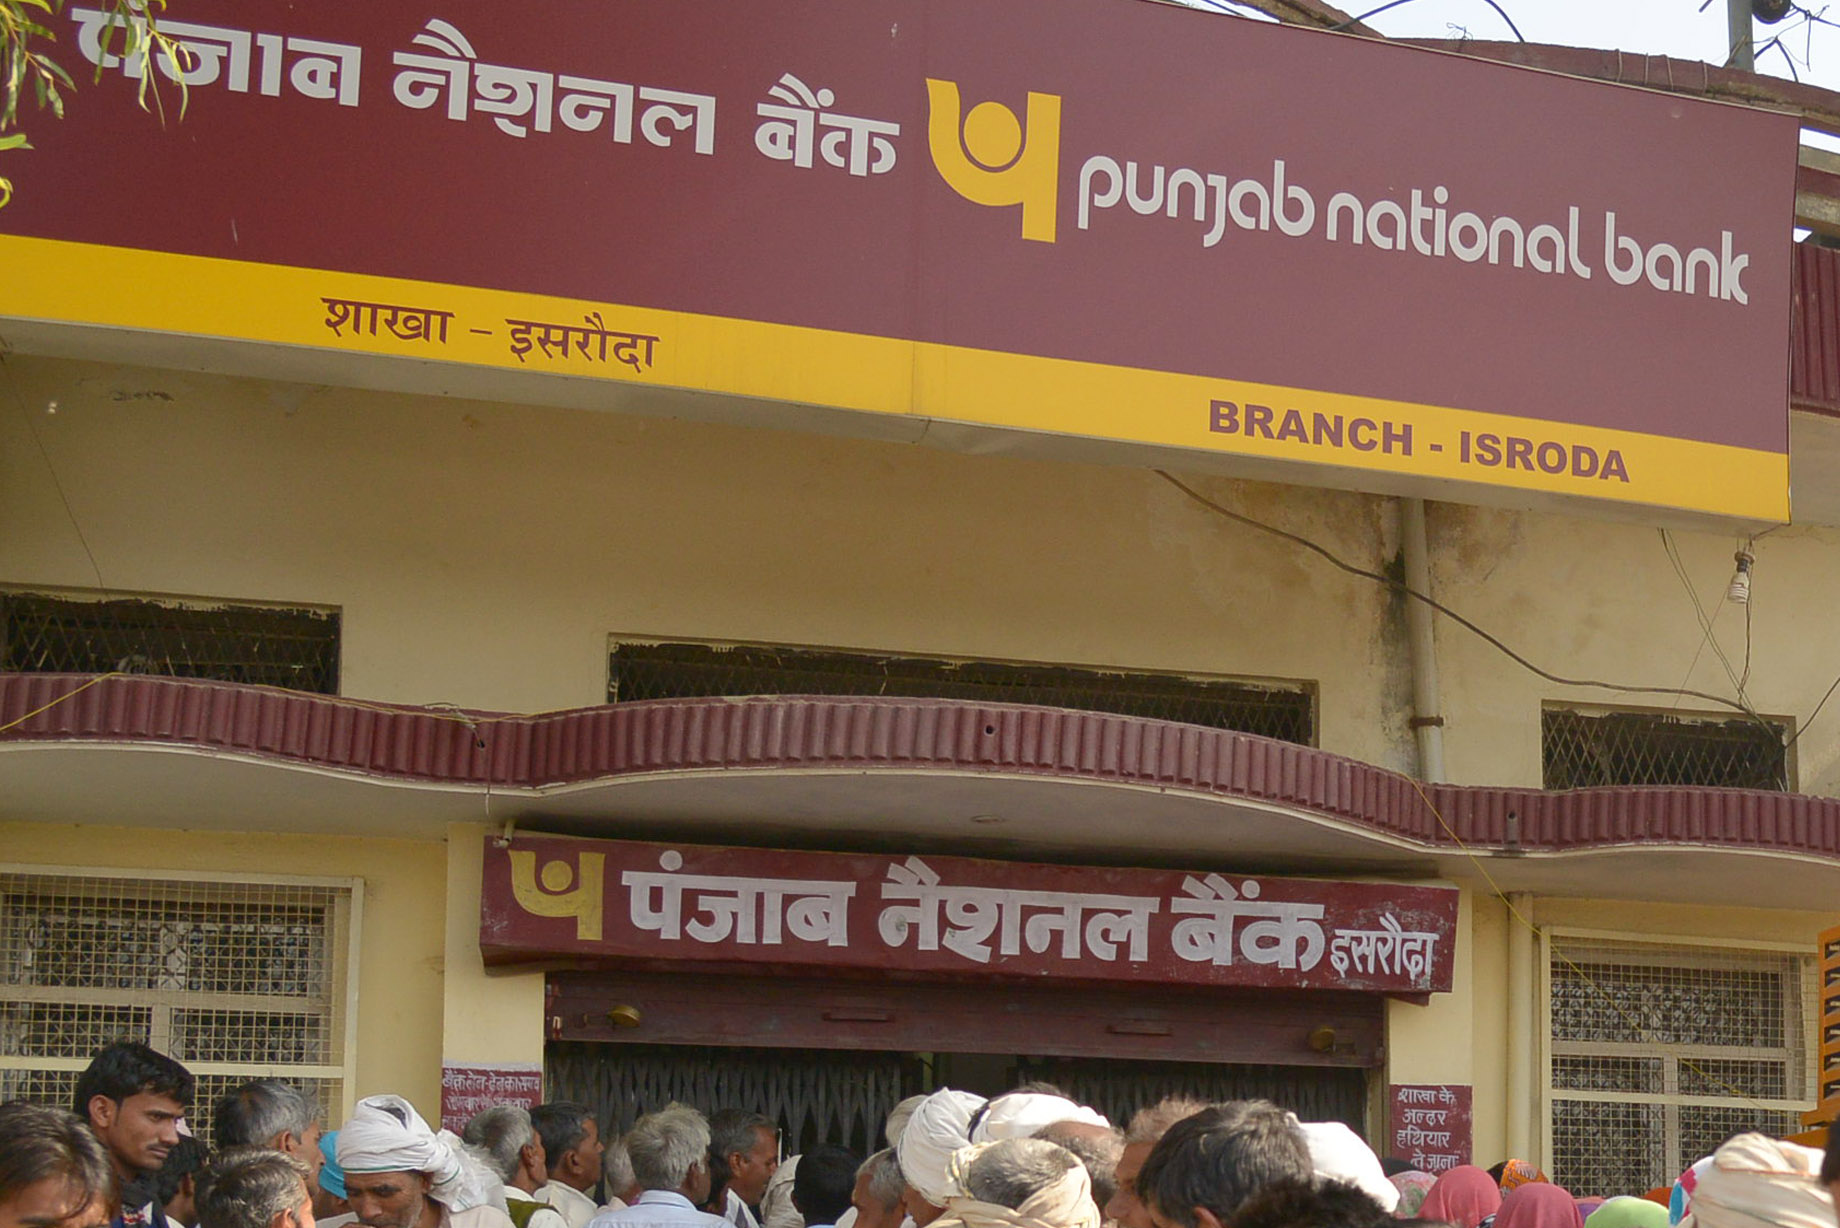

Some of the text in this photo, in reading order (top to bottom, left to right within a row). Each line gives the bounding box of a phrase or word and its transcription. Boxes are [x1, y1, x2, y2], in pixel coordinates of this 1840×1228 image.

[393, 18, 716, 155] नैशनल
[754, 73, 900, 177] बैंक
[1078, 155, 1749, 305] punjab national bank
[320, 297, 455, 344] शाखा
[505, 312, 661, 374] इसरौदा
[1209, 399, 1412, 457] BRANCH
[1459, 430, 1630, 484] ISRODA
[621, 849, 857, 947] पंजाब
[877, 855, 1160, 963] नैशनल
[1170, 872, 1325, 972] बैंक
[1397, 1085, 1456, 1105] शाखा के
